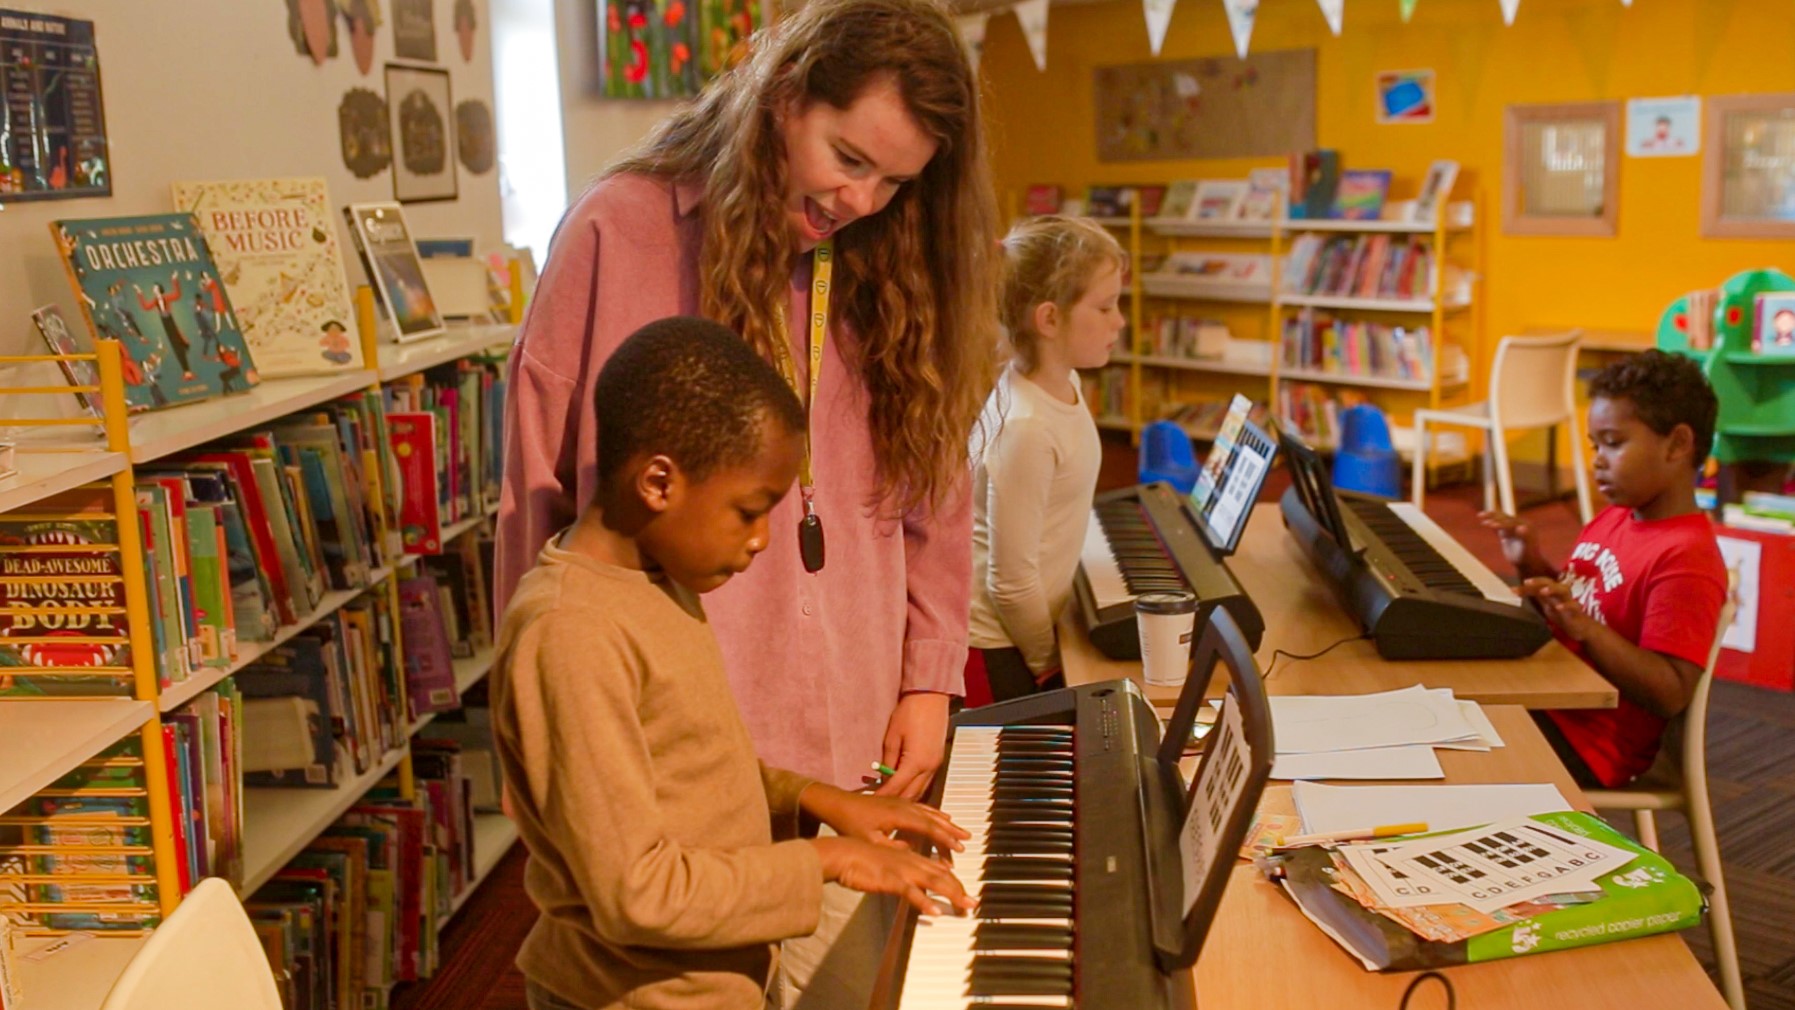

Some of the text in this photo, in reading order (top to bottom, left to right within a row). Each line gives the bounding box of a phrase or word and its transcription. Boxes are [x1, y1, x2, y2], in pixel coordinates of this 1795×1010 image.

[211, 208, 308, 231] BEFORE
[225, 230, 304, 252] MUSIC
[85, 237, 198, 270] ORCHESTRA
[4, 558, 112, 574] DEAD-AWESOME
[6, 582, 115, 598] DINOSAUR
[8, 600, 115, 629] BODY
[1472, 891, 1487, 899] C
[1487, 886, 1503, 894] D
[1505, 880, 1521, 888] E
[1521, 875, 1532, 883] F
[1554, 865, 1571, 874] A
[1568, 858, 1585, 867] B
[1585, 851, 1600, 861] C
[1396, 885, 1431, 895] C D
[1556, 922, 1605, 941] recycled
[1647, 911, 1682, 928] paper
